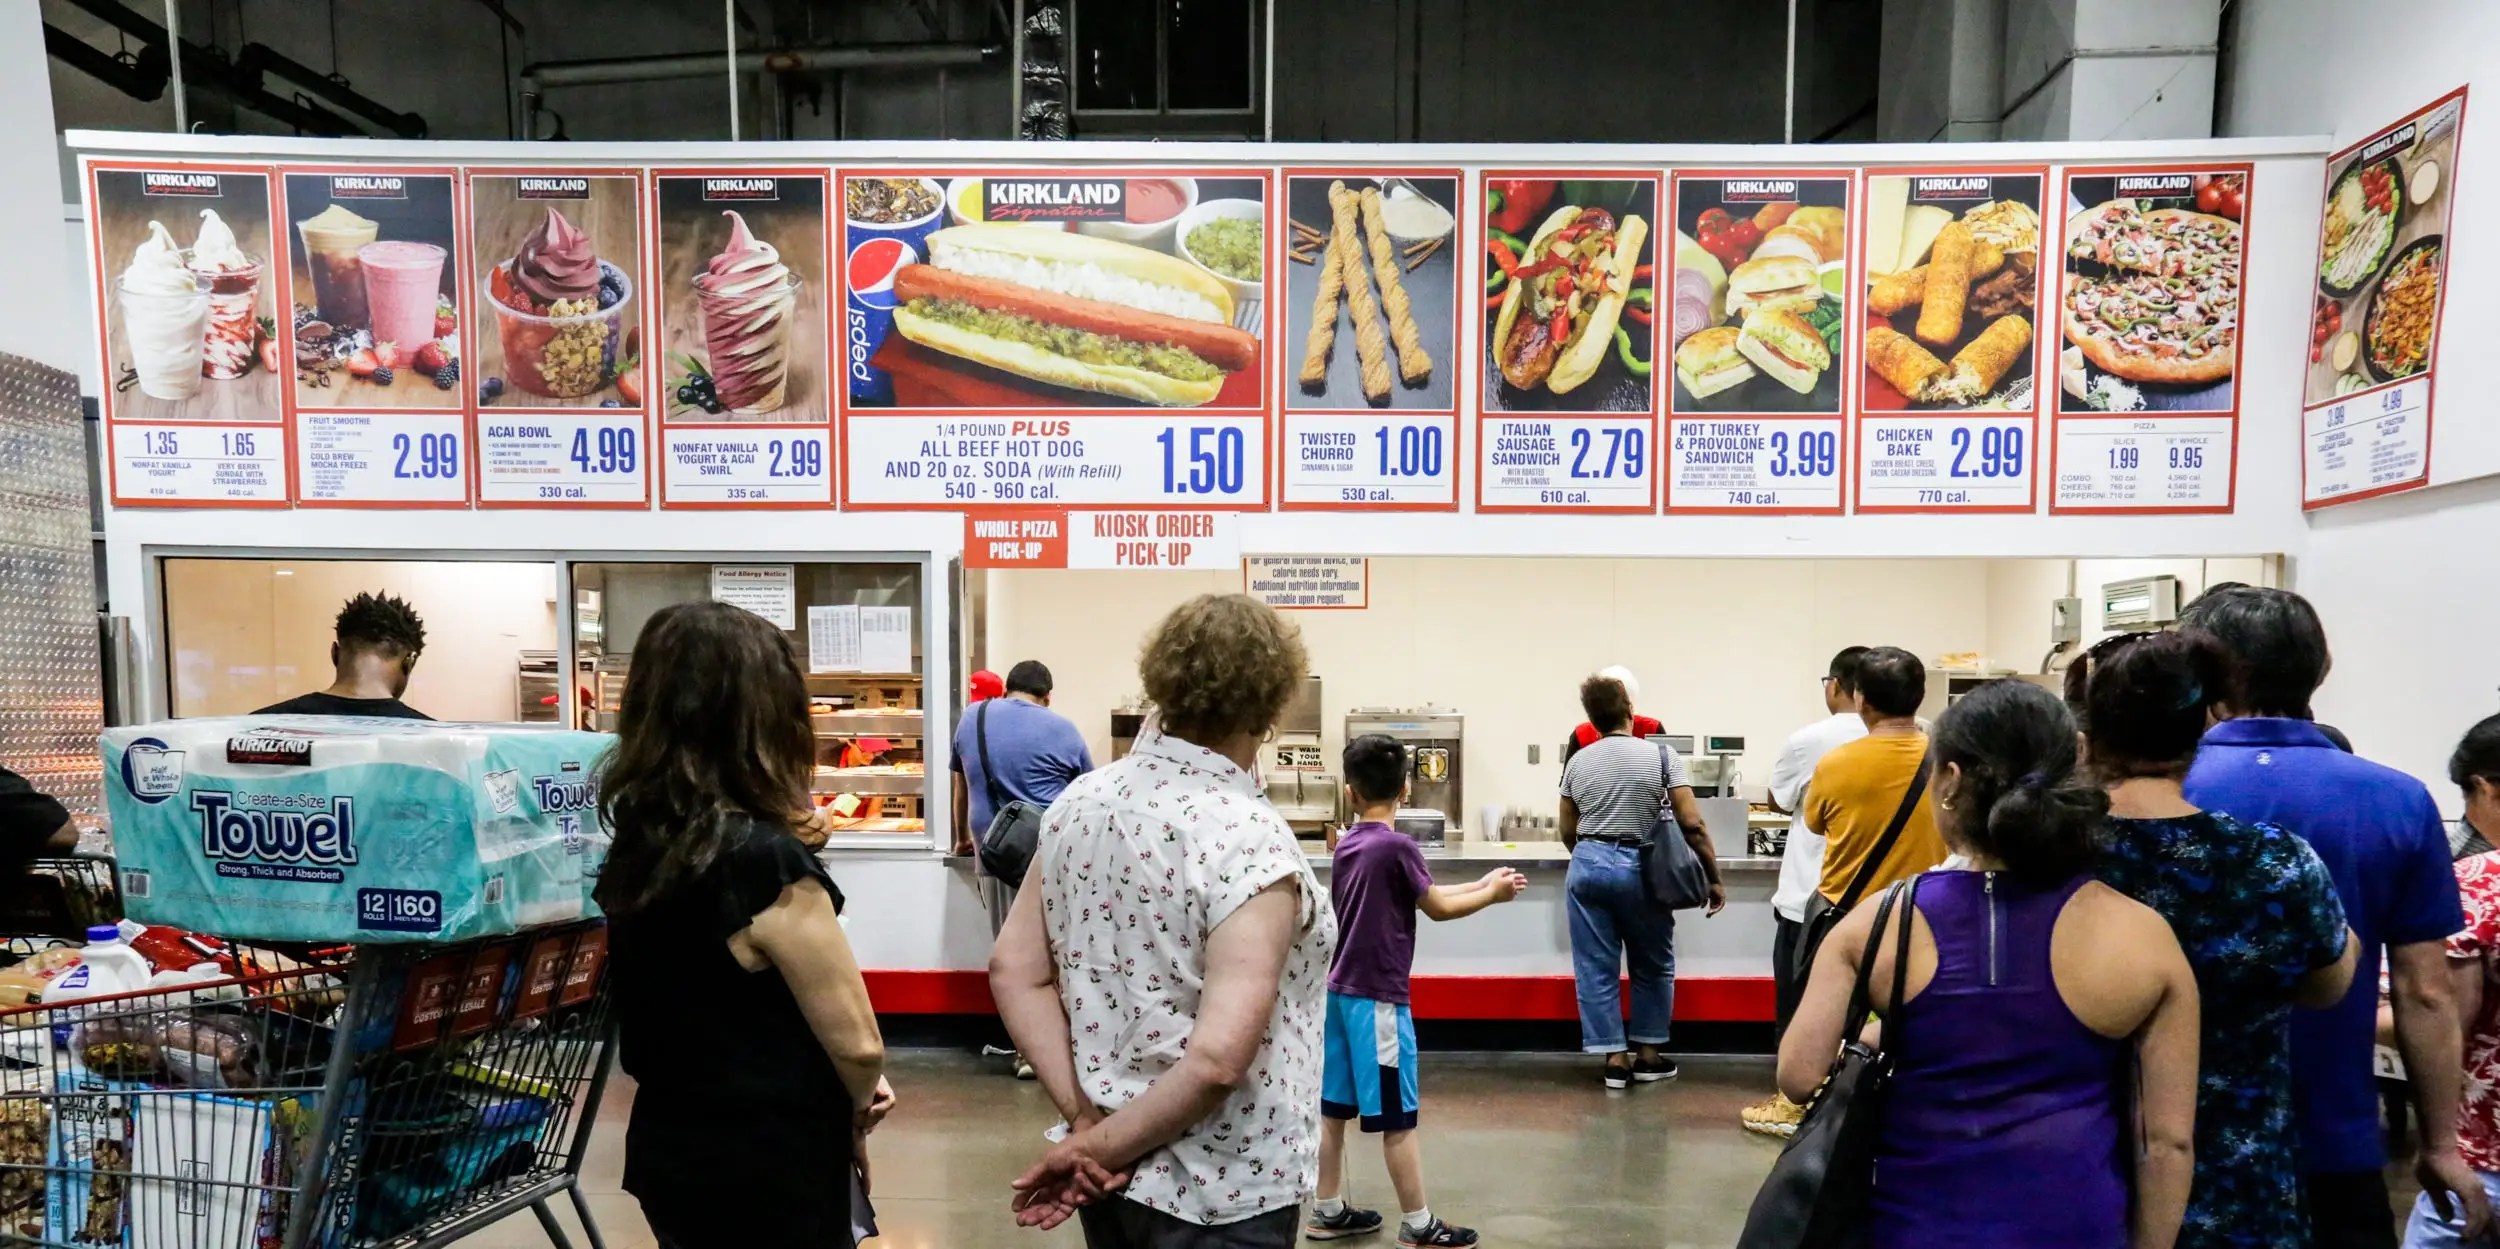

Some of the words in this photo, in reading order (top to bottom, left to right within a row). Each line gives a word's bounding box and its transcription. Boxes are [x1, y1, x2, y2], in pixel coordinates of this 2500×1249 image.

[146, 173, 217, 187] KIRKLAND
[335, 177, 402, 190] KIRKLAND
[520, 179, 587, 191] KIRKLAND
[707, 179, 774, 191] KIRKLAND
[1919, 178, 1988, 191] KIRKLAND
[2120, 176, 2191, 190] KIRKLAND
[990, 183, 1121, 204] KIRKLAND
[1727, 181, 1795, 194] KIRKLAND
[990, 203, 1114, 222] Signature
[849, 307, 872, 381] pepsi
[309, 417, 330, 425] FRUIT
[332, 417, 371, 425] SMOOTHIE
[2133, 422, 2156, 430] PIZZA
[488, 426, 514, 438] ACAI
[518, 426, 552, 438] BOWL
[936, 423, 956, 437] 1/4
[960, 423, 1006, 437] POUND
[1011, 420, 1071, 437] PLUS
[1502, 423, 1551, 436] ITALIAN
[1680, 423, 1706, 436] HOT
[1710, 423, 1760, 436] TURKEY
[1876, 428, 1933, 441] CHICKEN
[144, 431, 178, 455] 1.35
[222, 432, 255, 456] 1.65
[1300, 432, 1356, 446] TWISTED
[1497, 438, 1556, 451] SAUSAGE
[1675, 437, 1684, 450] &
[1689, 437, 1765, 450] PROVOLONE
[2179, 437, 2208, 445] WHOLE
[570, 427, 635, 473] 4.99
[673, 443, 712, 453] NONFAT
[715, 443, 759, 453] VANILLA
[920, 440, 953, 457] ALL
[958, 440, 1000, 457] BEEF
[1005, 440, 1041, 457] HOT
[1047, 440, 1084, 457] DOG
[1301, 447, 1354, 460] CHURRO
[1375, 425, 1442, 477] 1.00
[1570, 427, 1644, 479] 2.79
[1770, 430, 1836, 477] 3.99
[1887, 443, 1921, 456] BAKE
[1950, 426, 2023, 478] 2.99
[310, 453, 330, 461] COLD
[332, 453, 354, 461] BREW
[393, 433, 458, 478] 2.99
[677, 454, 717, 464] YOGURT
[720, 454, 728, 464] &
[731, 455, 755, 464] ACAI
[769, 439, 821, 477] 2.99
[1157, 426, 1244, 494] 1.50
[1491, 452, 1561, 466] SANDWICH
[1685, 451, 1754, 464] SANDWICH
[2108, 447, 2139, 469] 1.99
[2169, 446, 2203, 469] 9.95
[132, 461, 160, 469] NONFAT
[162, 461, 191, 470] VANILLA
[237, 463, 260, 471] BERRY
[311, 461, 339, 469] MOCHA
[340, 461, 368, 470] FREEZE
[700, 465, 733, 475] SWIRL
[885, 461, 921, 479] AND
[927, 461, 947, 479] 20
[953, 465, 977, 479] oz.
[983, 461, 1032, 479] SODA
[1037, 463, 1076, 481] (With
[1079, 463, 1123, 481] Refill)
[148, 469, 175, 477] YOGURT
[213, 478, 267, 486] STRAWBERRIES
[539, 486, 562, 497] 330
[565, 486, 587, 498] cal.
[727, 489, 746, 498] 335
[750, 489, 768, 499] cal.
[945, 482, 976, 499] 540
[993, 482, 1025, 499] 960
[1030, 482, 1060, 499] cal.
[1342, 487, 1366, 500] 530
[1369, 487, 1395, 500] cal.
[1540, 490, 1563, 503] 610
[1567, 490, 1591, 503] cal.
[1919, 490, 1942, 503] 770
[1946, 490, 1971, 503] cal.
[1728, 491, 1752, 504] 740
[1756, 491, 1781, 504] cal.
[974, 520, 1019, 538] WHOLE
[1021, 520, 1058, 538] PIZZA
[1094, 514, 1149, 538] KIOSK
[1156, 514, 1214, 538] ORDER
[989, 541, 1043, 560] PICK-UP
[1116, 542, 1192, 566] PICK-UP
[738, 570, 762, 578] Allergy
[1272, 568, 1297, 578] calorie
[1299, 568, 1320, 578] needs
[1252, 580, 1287, 591] Additional
[1288, 580, 1318, 591] nutrition
[1319, 580, 1360, 591] information
[1298, 595, 1315, 606] upon
[1316, 594, 1346, 606] request.
[229, 737, 312, 754] KIRKLAND
[236, 790, 326, 810] Create-a-Size
[191, 789, 359, 866] Towel
[219, 864, 249, 877] Strong,
[251, 866, 275, 877] Thick
[276, 867, 294, 878] and
[295, 868, 341, 881] Absorbent
[362, 893, 385, 912] 12
[394, 895, 437, 917] 160
[362, 912, 385, 921] ROLLS
